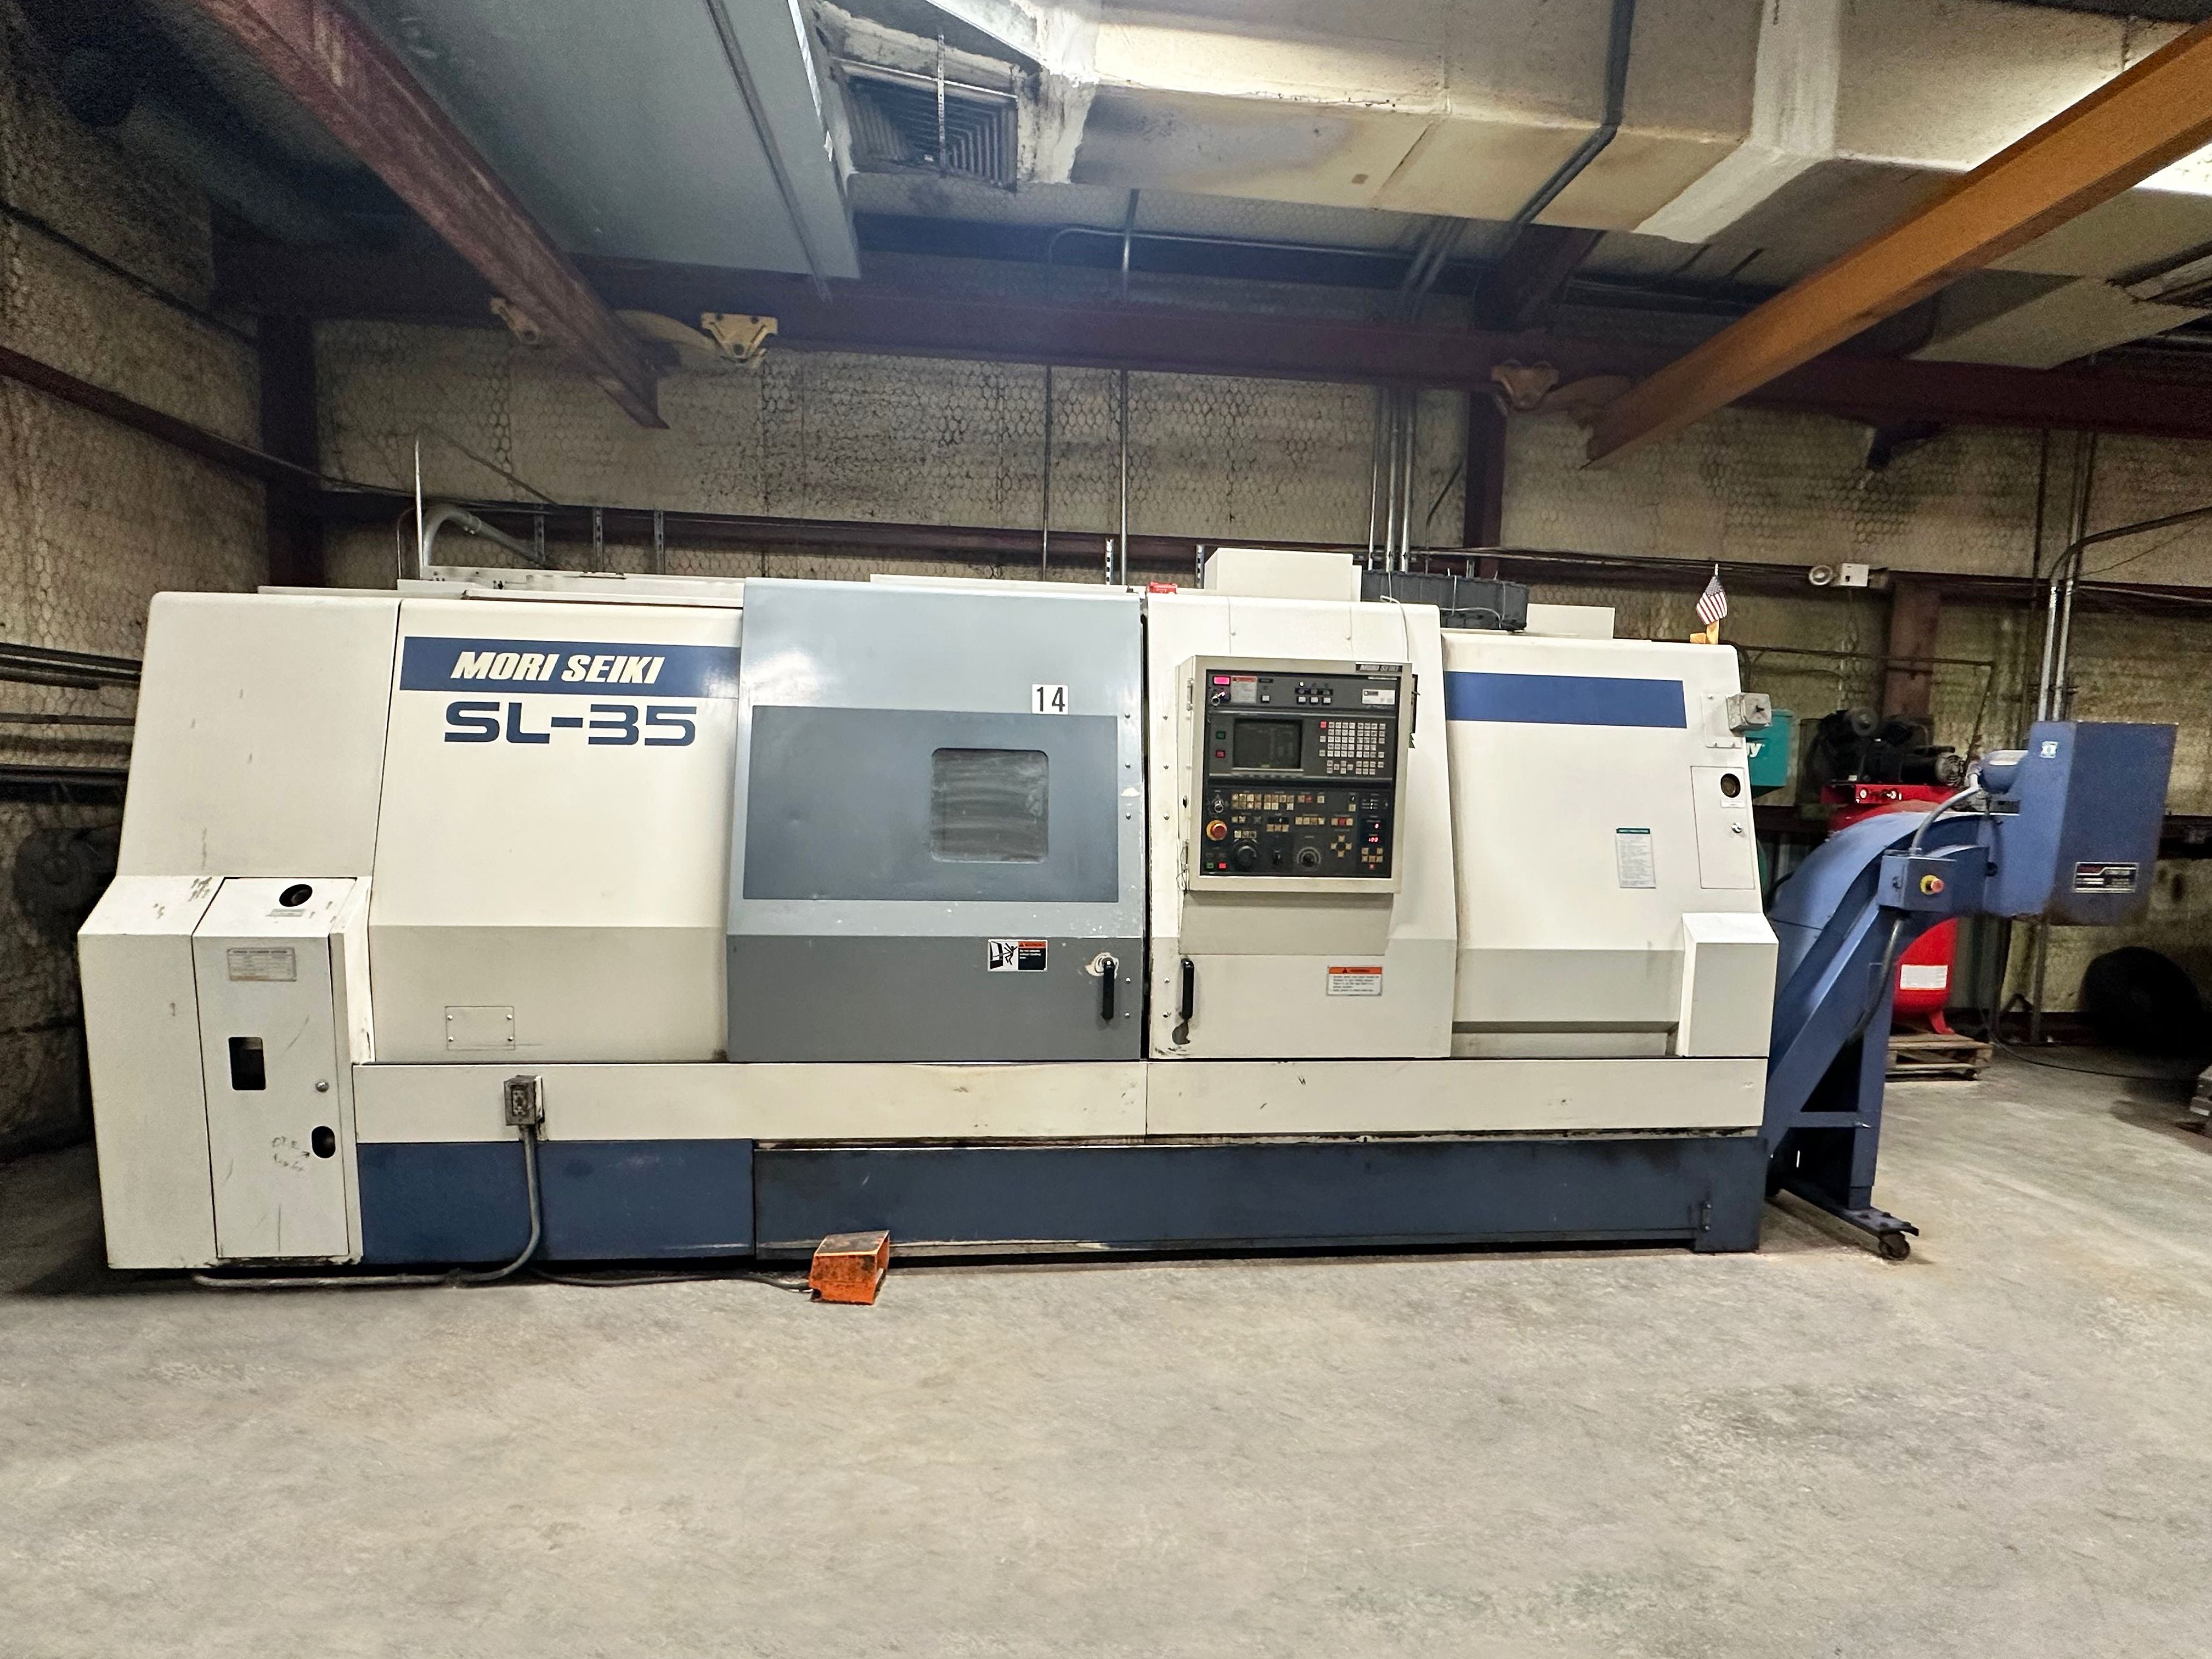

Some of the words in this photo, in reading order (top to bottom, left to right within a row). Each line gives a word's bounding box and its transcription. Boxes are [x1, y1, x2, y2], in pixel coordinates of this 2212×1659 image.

[451, 651, 559, 681] MORI
[561, 654, 665, 684] SEIKI
[1036, 686, 1065, 712] 14
[444, 701, 697, 746] SL-35
